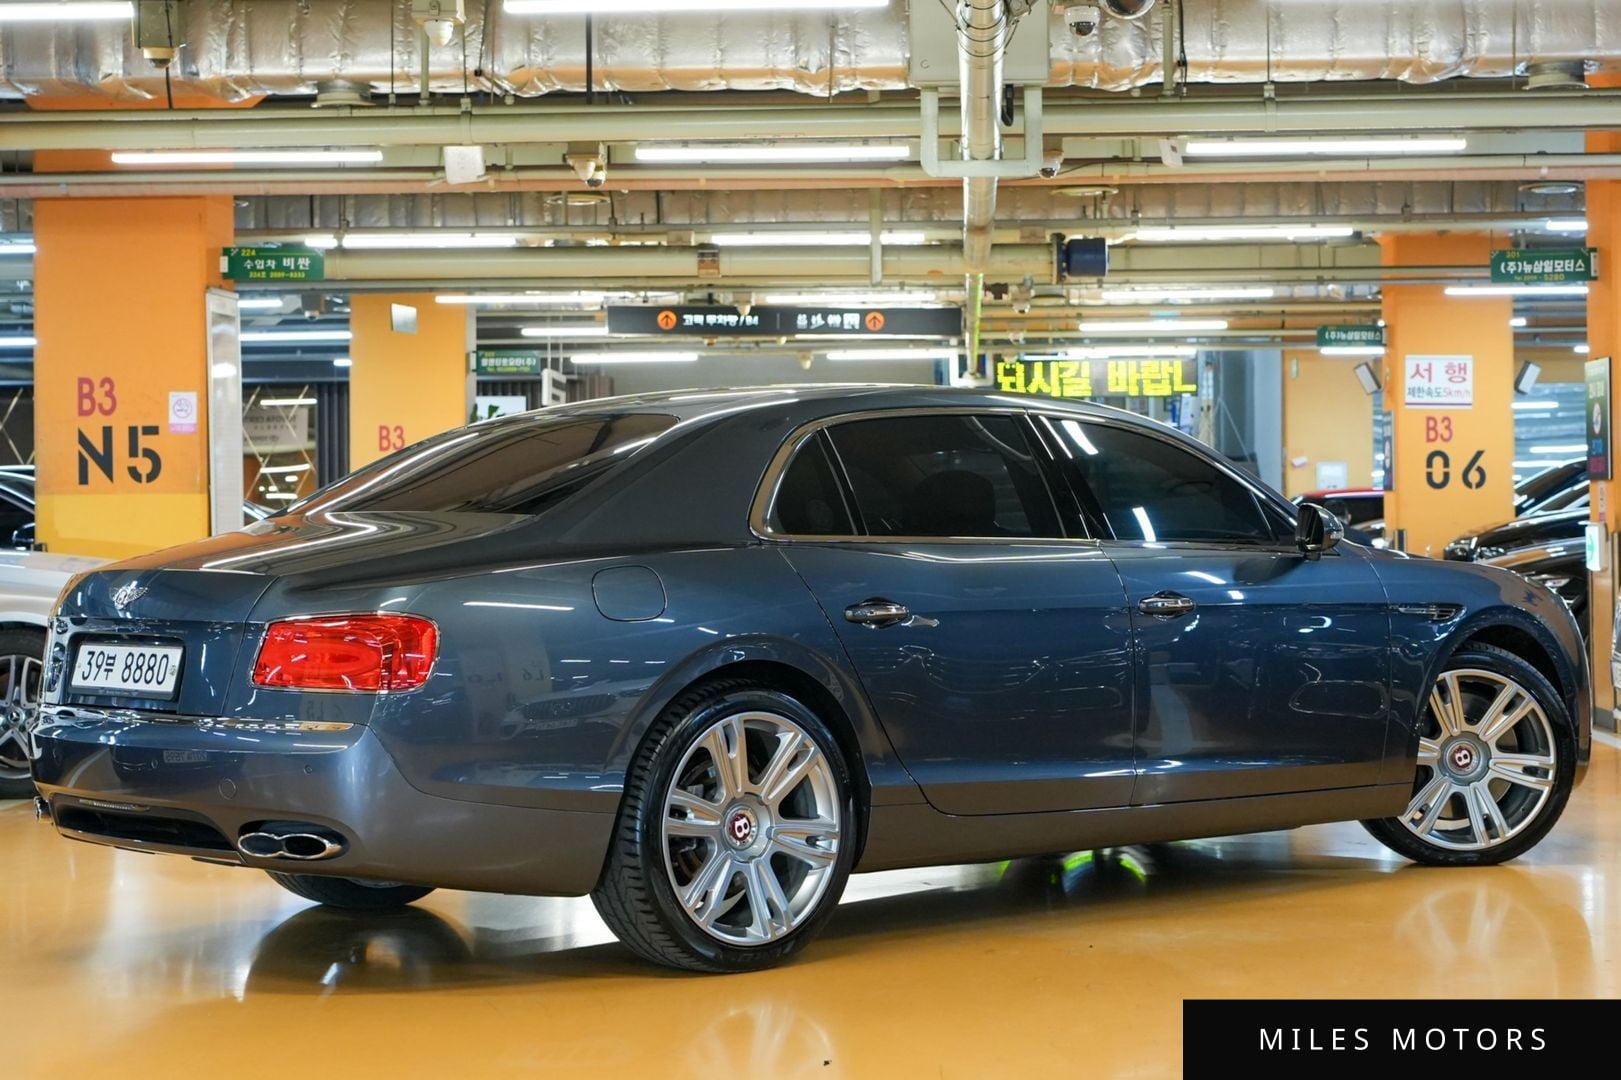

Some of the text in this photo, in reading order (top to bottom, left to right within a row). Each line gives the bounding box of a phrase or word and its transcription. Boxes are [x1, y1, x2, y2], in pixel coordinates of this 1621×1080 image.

[241, 248, 256, 257] 224
[243, 257, 311, 270] 수입차 비싼
[78, 376, 117, 417] B3
[379, 425, 405, 451] B3
[1425, 415, 1453, 443] B3
[82, 650, 169, 685] 39부 8880
